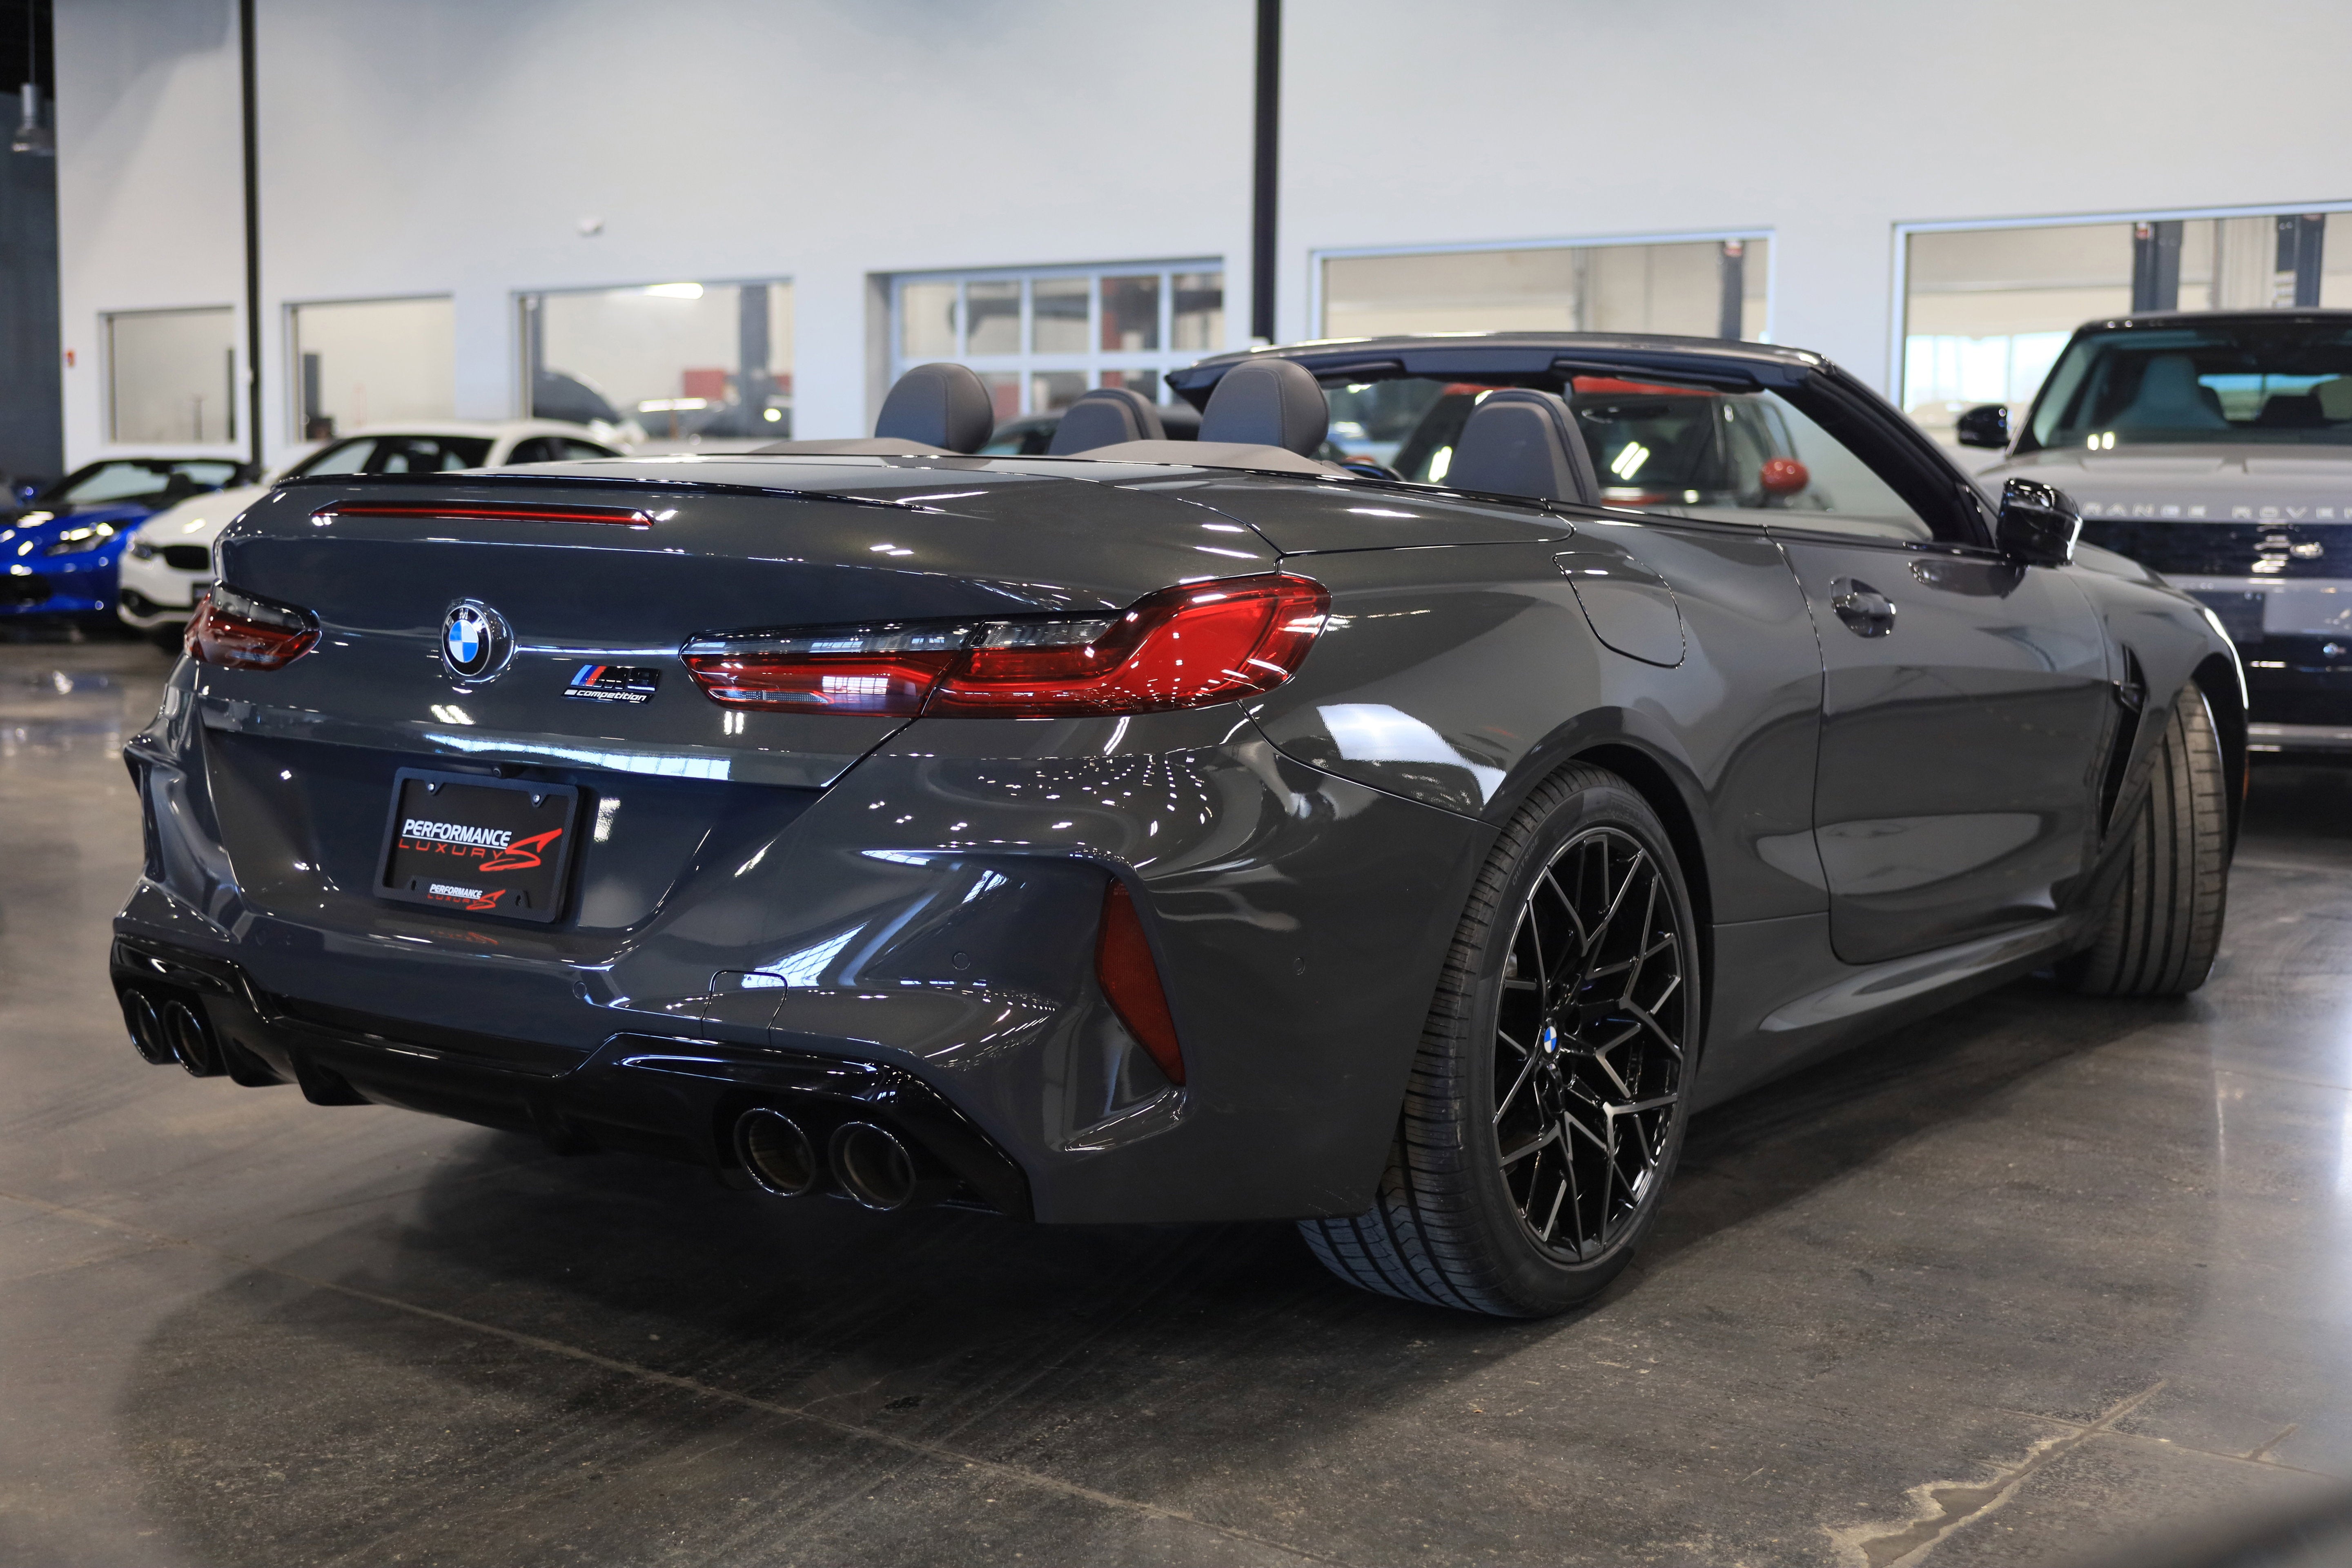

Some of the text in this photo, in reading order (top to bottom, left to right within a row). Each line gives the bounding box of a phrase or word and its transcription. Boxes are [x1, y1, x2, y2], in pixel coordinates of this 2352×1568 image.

[2083, 502, 2206, 518] RANGE
[445, 608, 486, 633] BMW
[577, 690, 647, 701] competition
[403, 819, 512, 847] PERFORMANCE
[399, 839, 504, 860] LUXURY
[1512, 836, 1539, 886] OUTSIDE
[430, 884, 483, 898] PERFORMANCE
